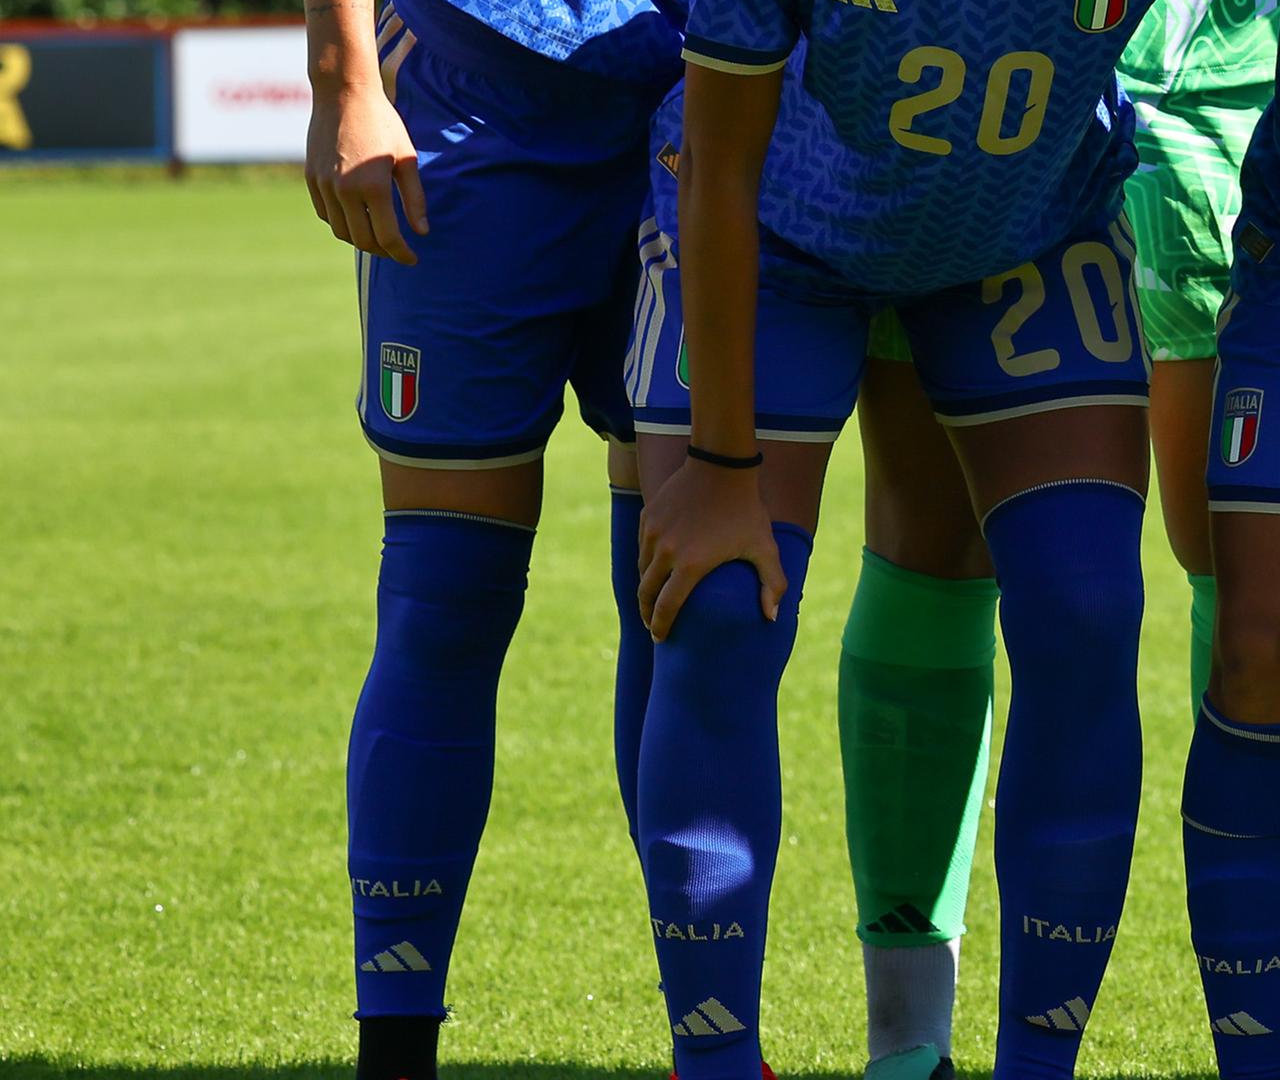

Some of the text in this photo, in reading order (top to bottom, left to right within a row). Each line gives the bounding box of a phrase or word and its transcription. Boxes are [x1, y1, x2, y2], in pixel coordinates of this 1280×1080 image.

[889, 46, 1055, 156] 20
[981, 241, 1133, 377] 20
[383, 347, 416, 368] ITALIA
[1227, 394, 1258, 411] ITALIA
[652, 918, 745, 941] TALIA
